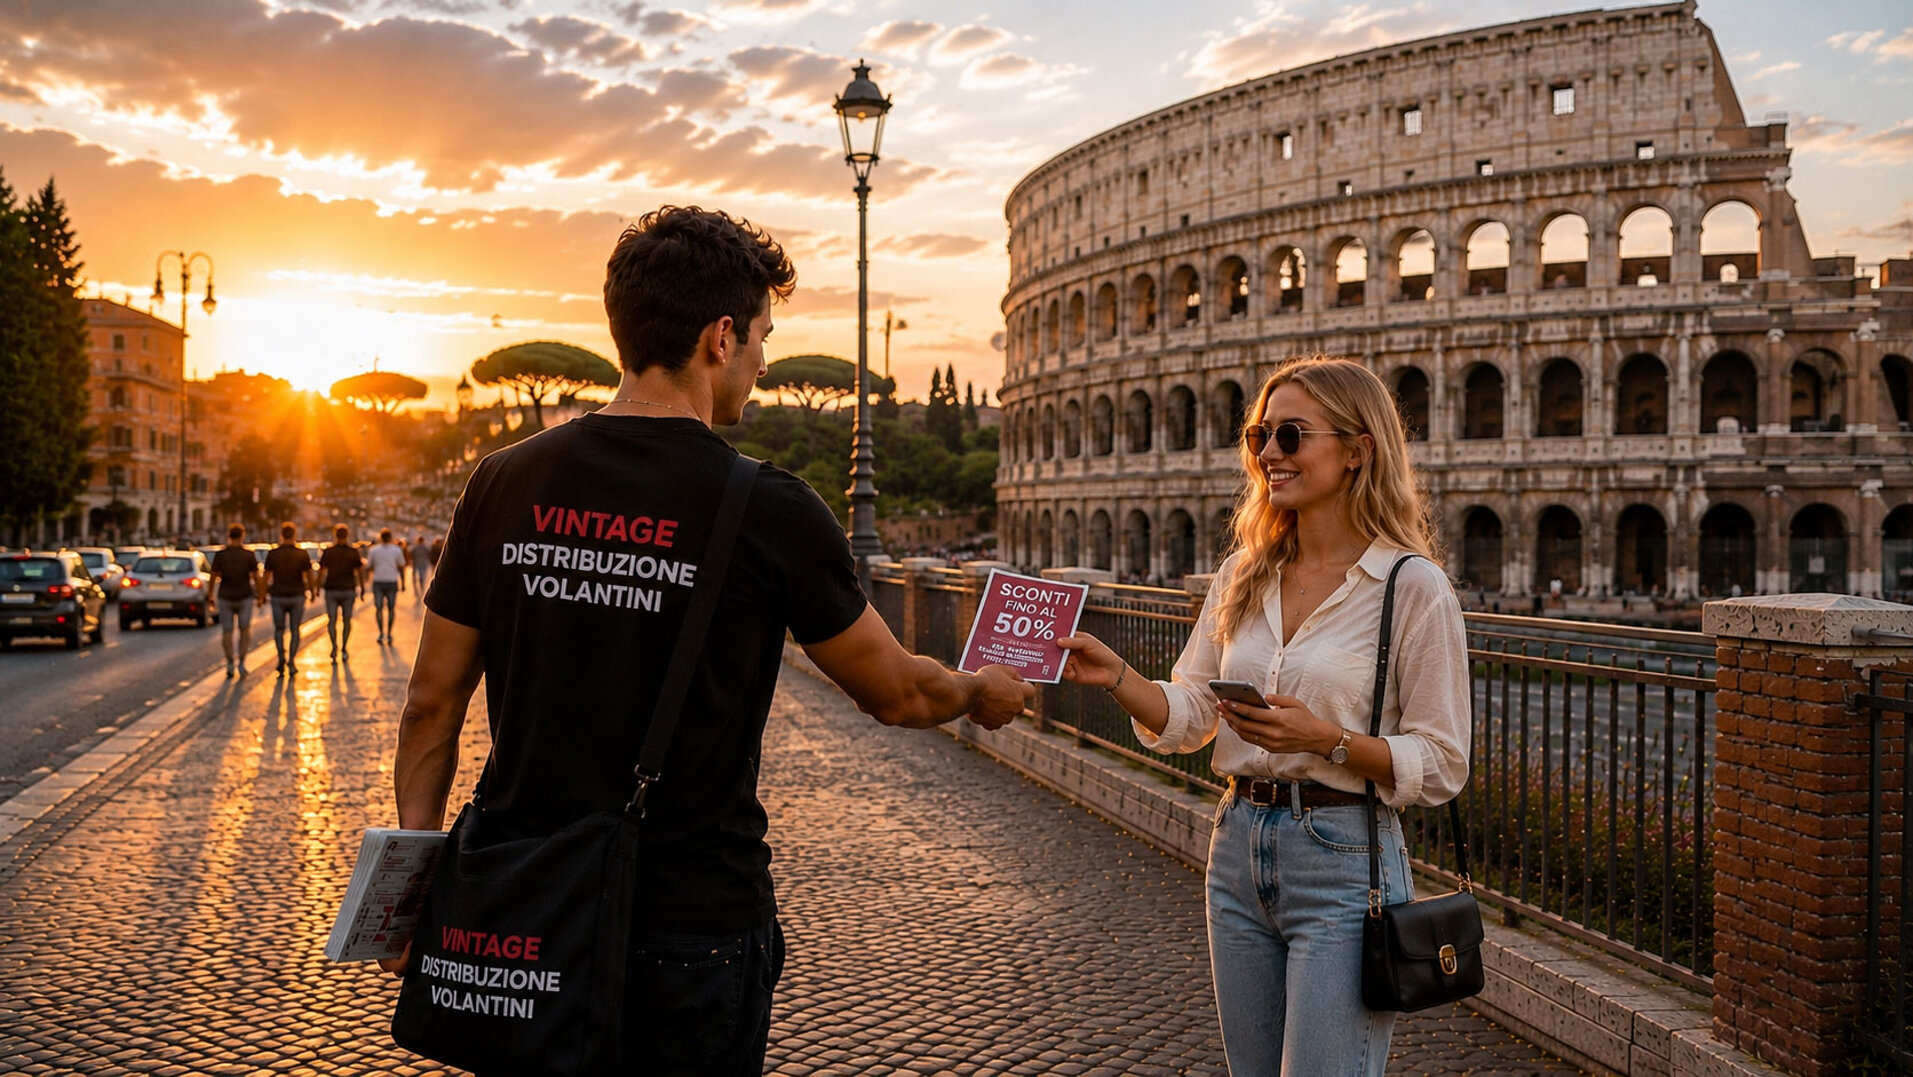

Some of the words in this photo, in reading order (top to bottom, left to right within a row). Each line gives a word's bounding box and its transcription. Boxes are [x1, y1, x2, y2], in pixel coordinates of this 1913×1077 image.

[533, 504, 679, 548] VINTAGE
[502, 542, 698, 587] DISTRIBUZIONE
[522, 573, 663, 612] VOLANTINI
[1000, 582, 1071, 607] SCONTI
[1005, 600, 1037, 615] FINO
[1039, 606, 1057, 619] AL
[993, 611, 1055, 641] 50%
[442, 925, 542, 961] VINTAGE
[421, 954, 561, 992] DISTRIBUZIONE
[431, 985, 534, 1019] VOLANTINI
